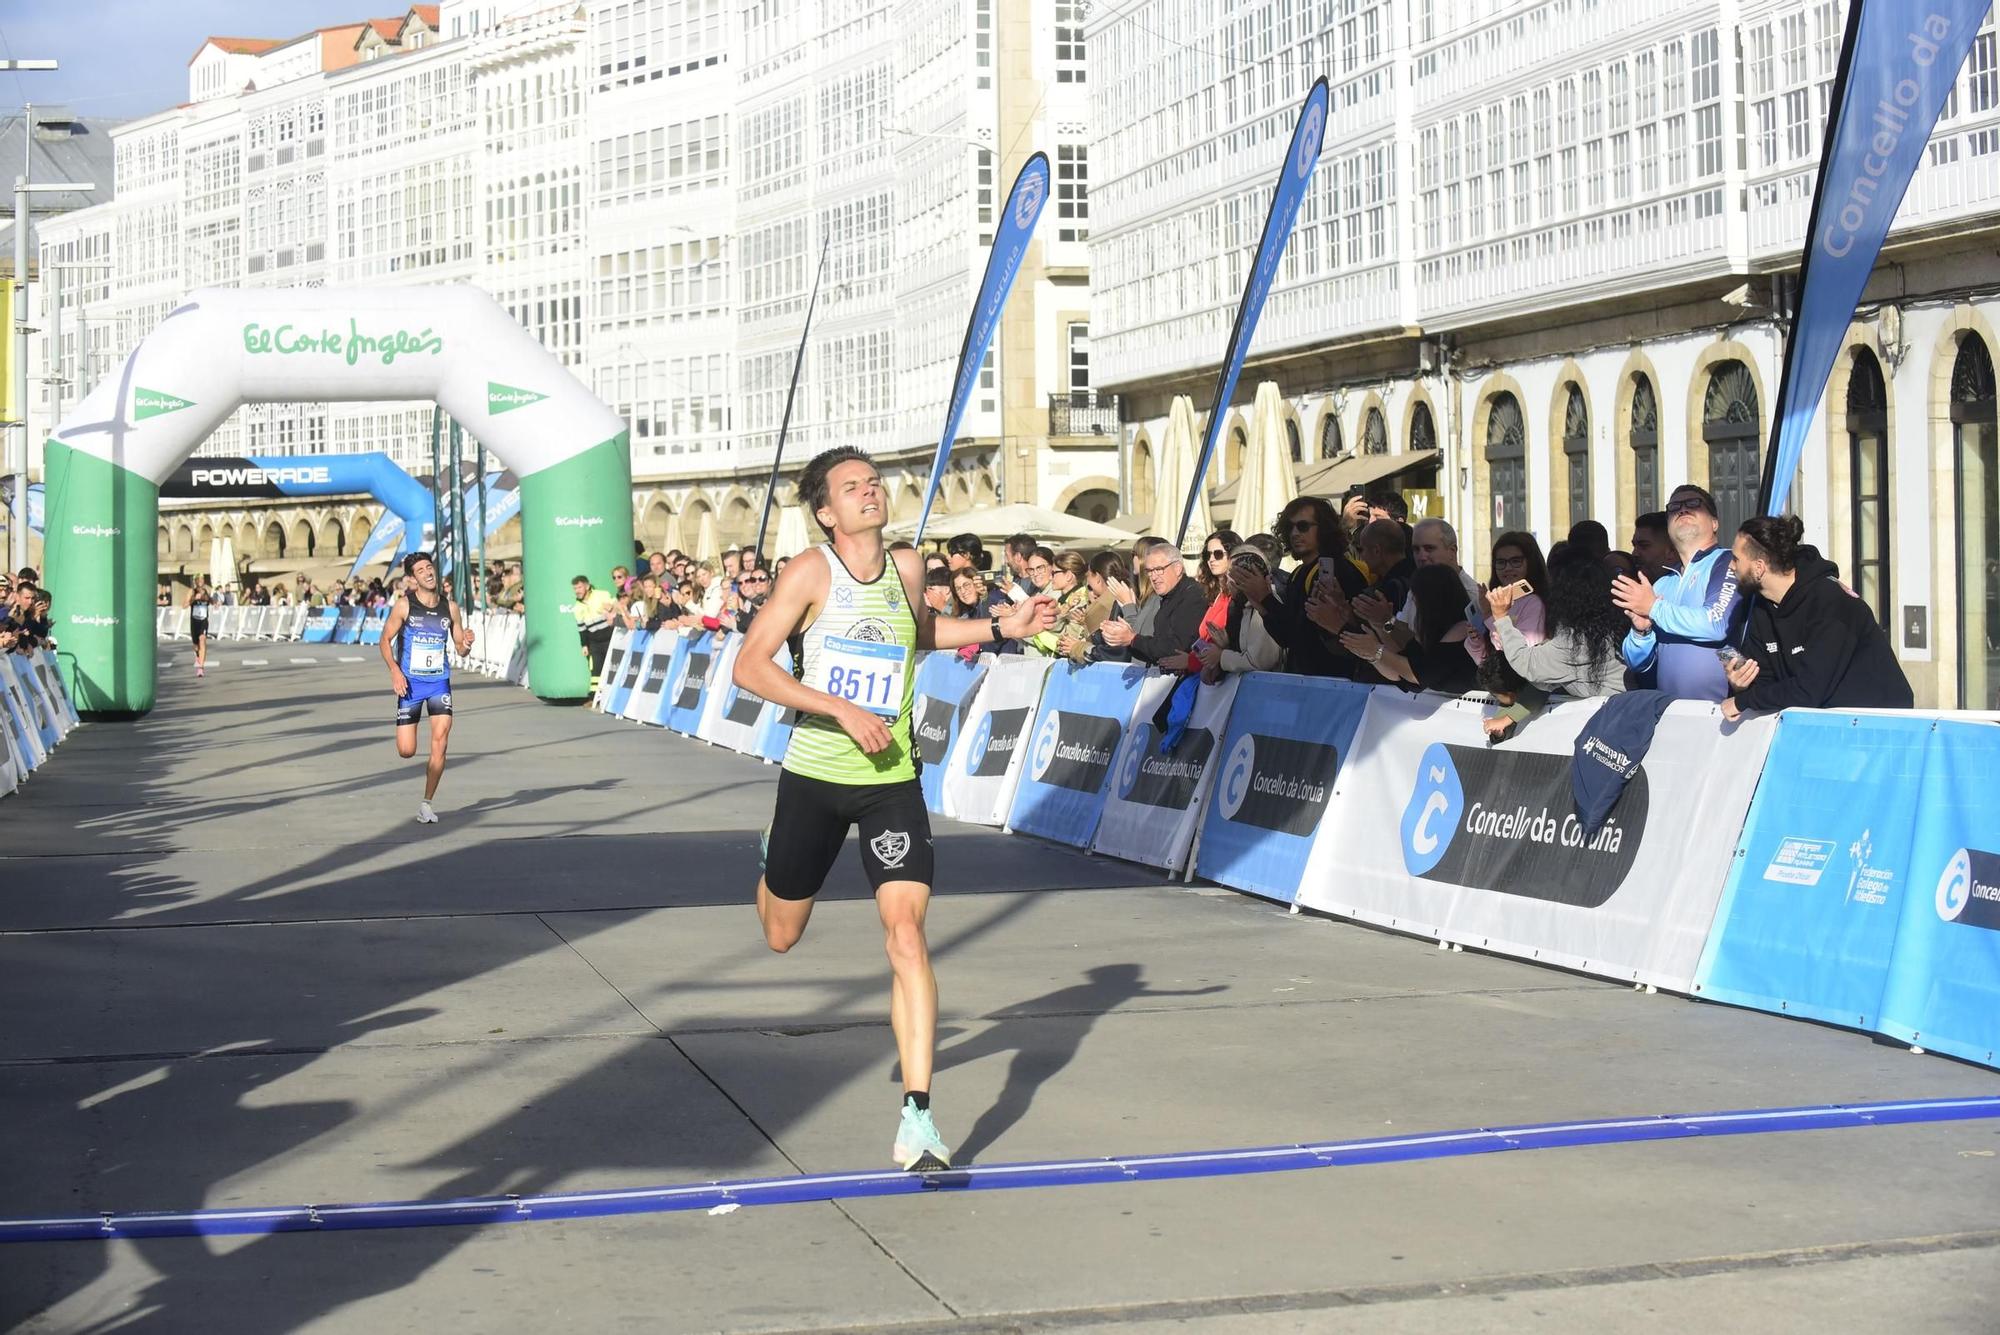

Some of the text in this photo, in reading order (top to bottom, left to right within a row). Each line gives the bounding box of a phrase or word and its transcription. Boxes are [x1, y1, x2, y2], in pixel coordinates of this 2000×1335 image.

[1823, 14, 1951, 258] Concello da
[243, 317, 441, 366] El Corte Inglés
[976, 322, 990, 348] da
[191, 466, 332, 487] POWERADE
[426, 655, 432, 668] 6
[827, 665, 892, 705] 8511
[1056, 740, 1083, 762] Concello
[1253, 770, 1286, 796] Concello
[1285, 776, 1298, 798] da
[1466, 802, 1529, 839] Concello
[1530, 807, 1555, 844] da
